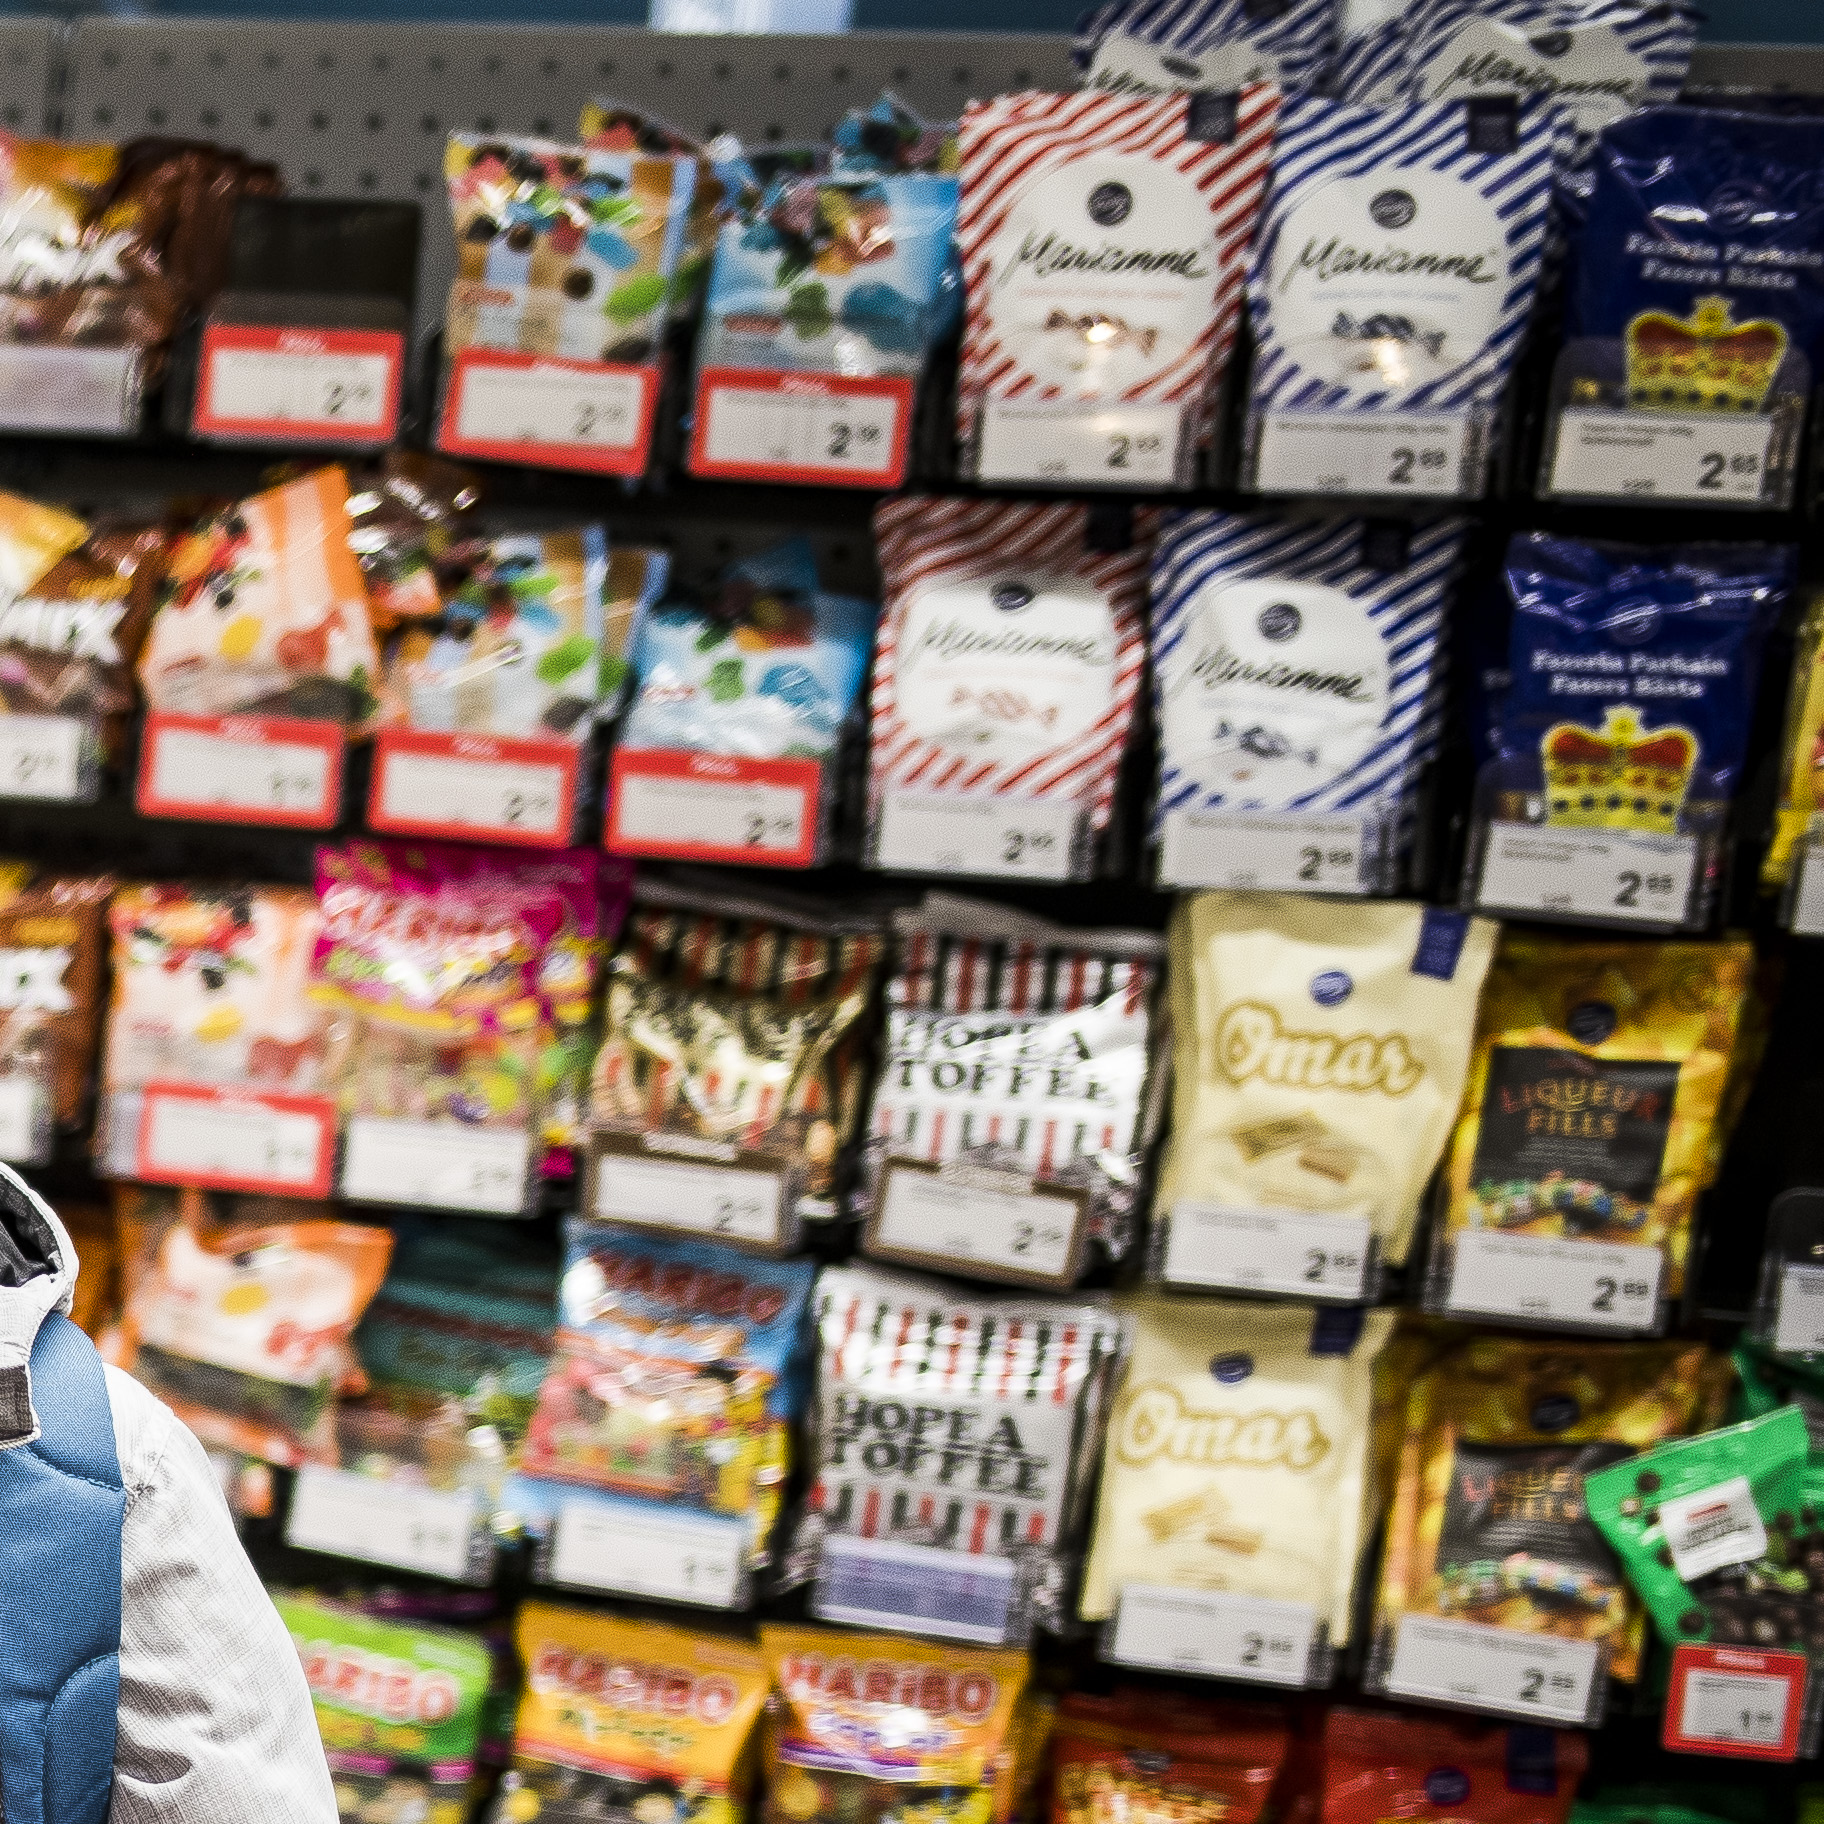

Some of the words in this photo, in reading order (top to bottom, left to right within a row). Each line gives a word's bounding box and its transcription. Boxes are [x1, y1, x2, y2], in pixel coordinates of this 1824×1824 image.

[999, 230, 1210, 286] Marianne
[1279, 235, 1498, 295] Marianne
[1160, 647, 1378, 703] Marianne
[1215, 1001, 1427, 1098] Omar
[1115, 1382, 1332, 1475] Omar
[779, 1648, 1001, 1725] HARIBO
